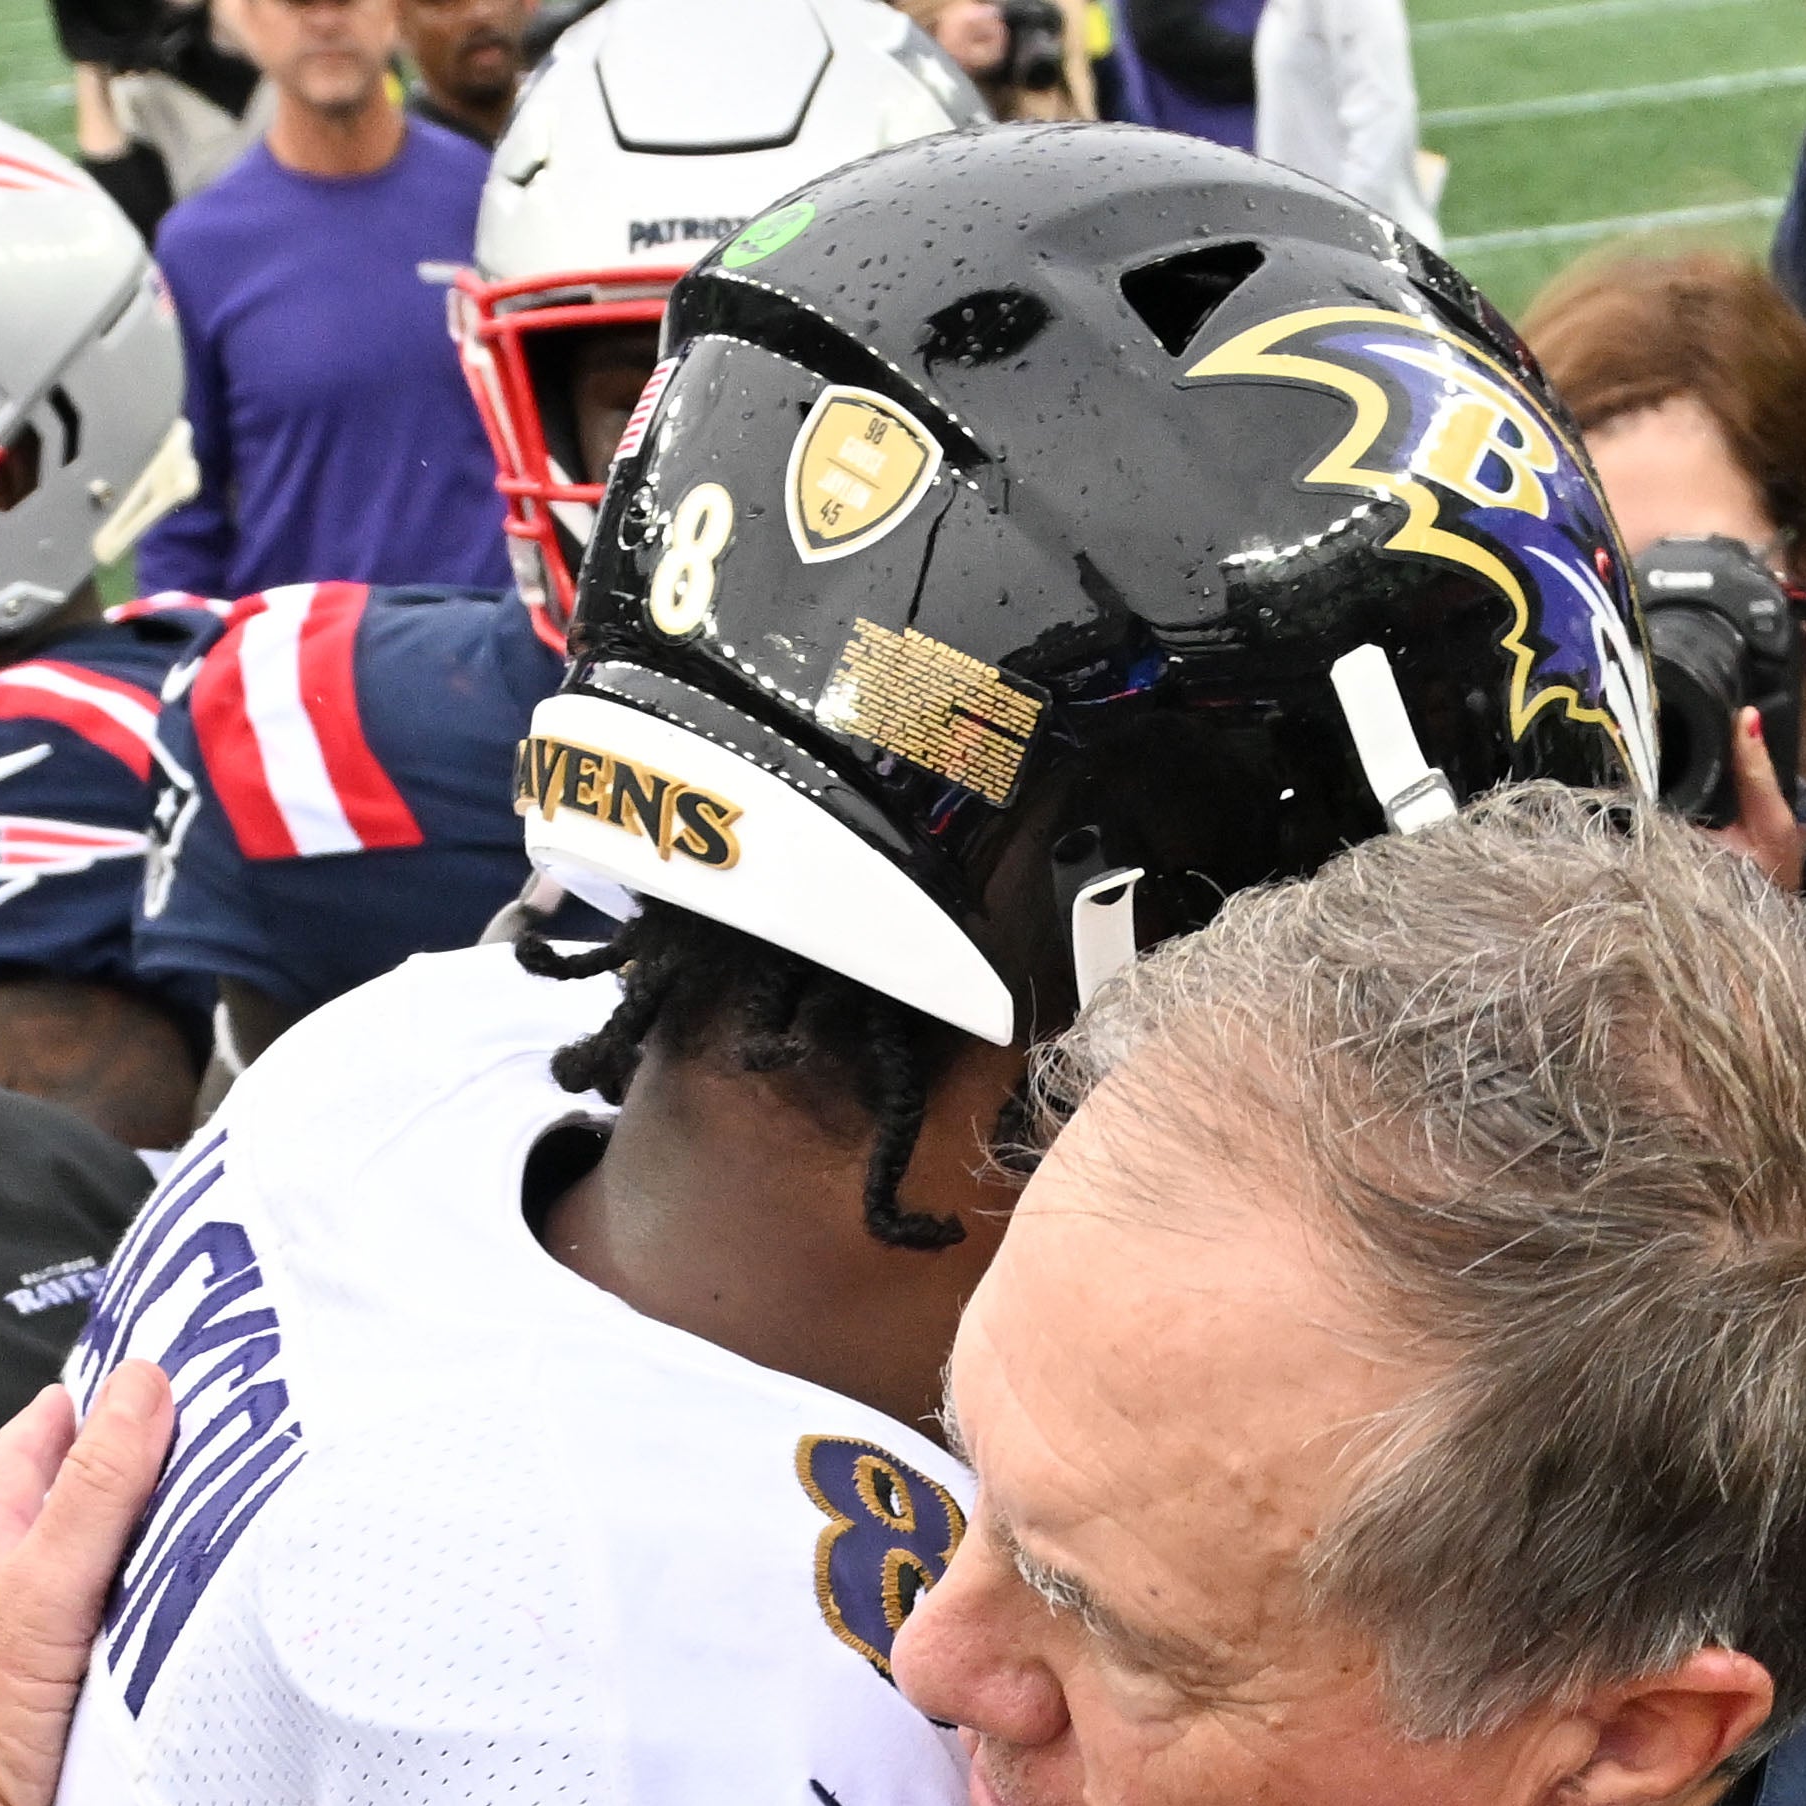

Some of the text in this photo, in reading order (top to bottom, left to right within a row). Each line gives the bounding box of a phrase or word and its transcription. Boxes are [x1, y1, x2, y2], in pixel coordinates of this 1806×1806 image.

[628, 216, 750, 253] PATRIO
[820, 499, 844, 526] 45
[650, 482, 735, 635] 8
[903, 627, 1001, 681] WARNING
[794, 1434, 968, 1690] 8
